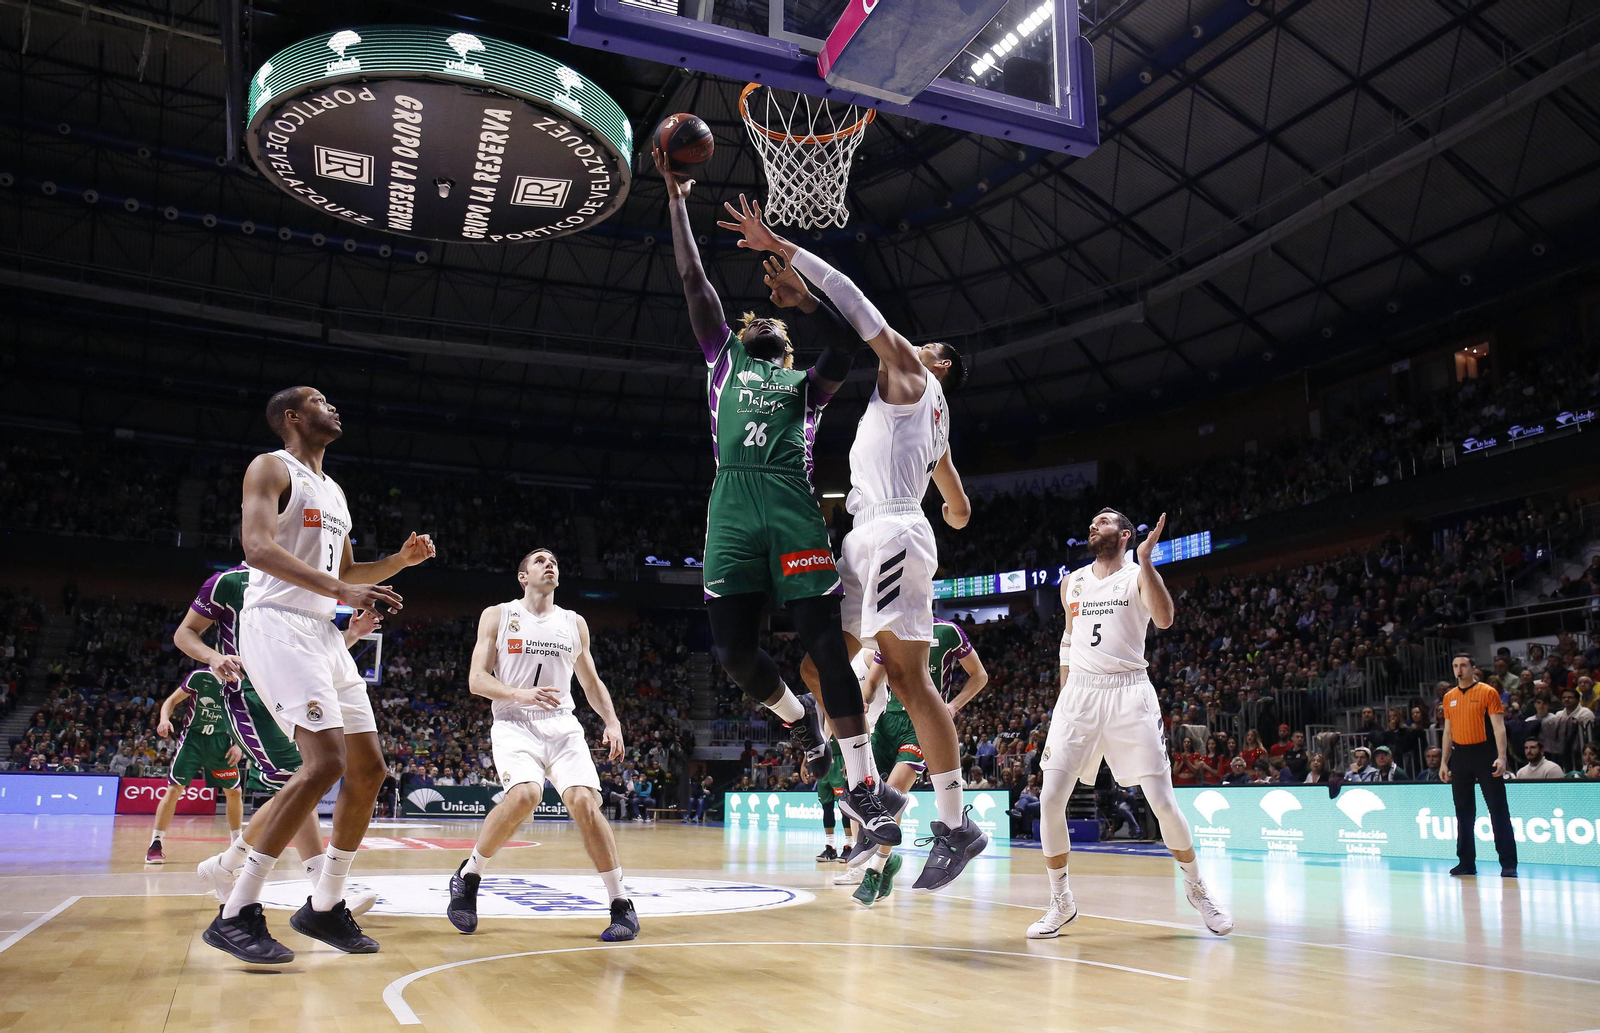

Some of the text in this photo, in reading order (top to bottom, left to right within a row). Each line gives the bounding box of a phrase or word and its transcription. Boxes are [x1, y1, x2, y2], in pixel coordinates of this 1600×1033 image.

[265, 87, 377, 225] PORTICO DE VELAZQUEZ
[387, 94, 424, 231] GRUPO LA RESERVA
[462, 108, 513, 240] GRUPO LA RESERVA
[489, 116, 611, 242] PORTICO DE VELAZQUEZ
[760, 382, 799, 394] Unicaja
[738, 389, 785, 413] Málaga
[743, 421, 768, 447] 26
[326, 543, 335, 572] 3
[786, 554, 834, 569] worten
[1031, 570, 1048, 586] 19
[1082, 599, 1130, 608] Universidad
[1081, 608, 1115, 617] Europea
[1090, 623, 1102, 647] 5
[525, 639, 573, 654] Universidad
[525, 647, 561, 658] Europea
[532, 663, 543, 688] 1
[201, 724, 215, 736] 10
[441, 801, 486, 814] Unicaja
[533, 801, 568, 815] nicaja
[1338, 829, 1388, 840] Fundación
[1346, 844, 1381, 856] Unicaja
